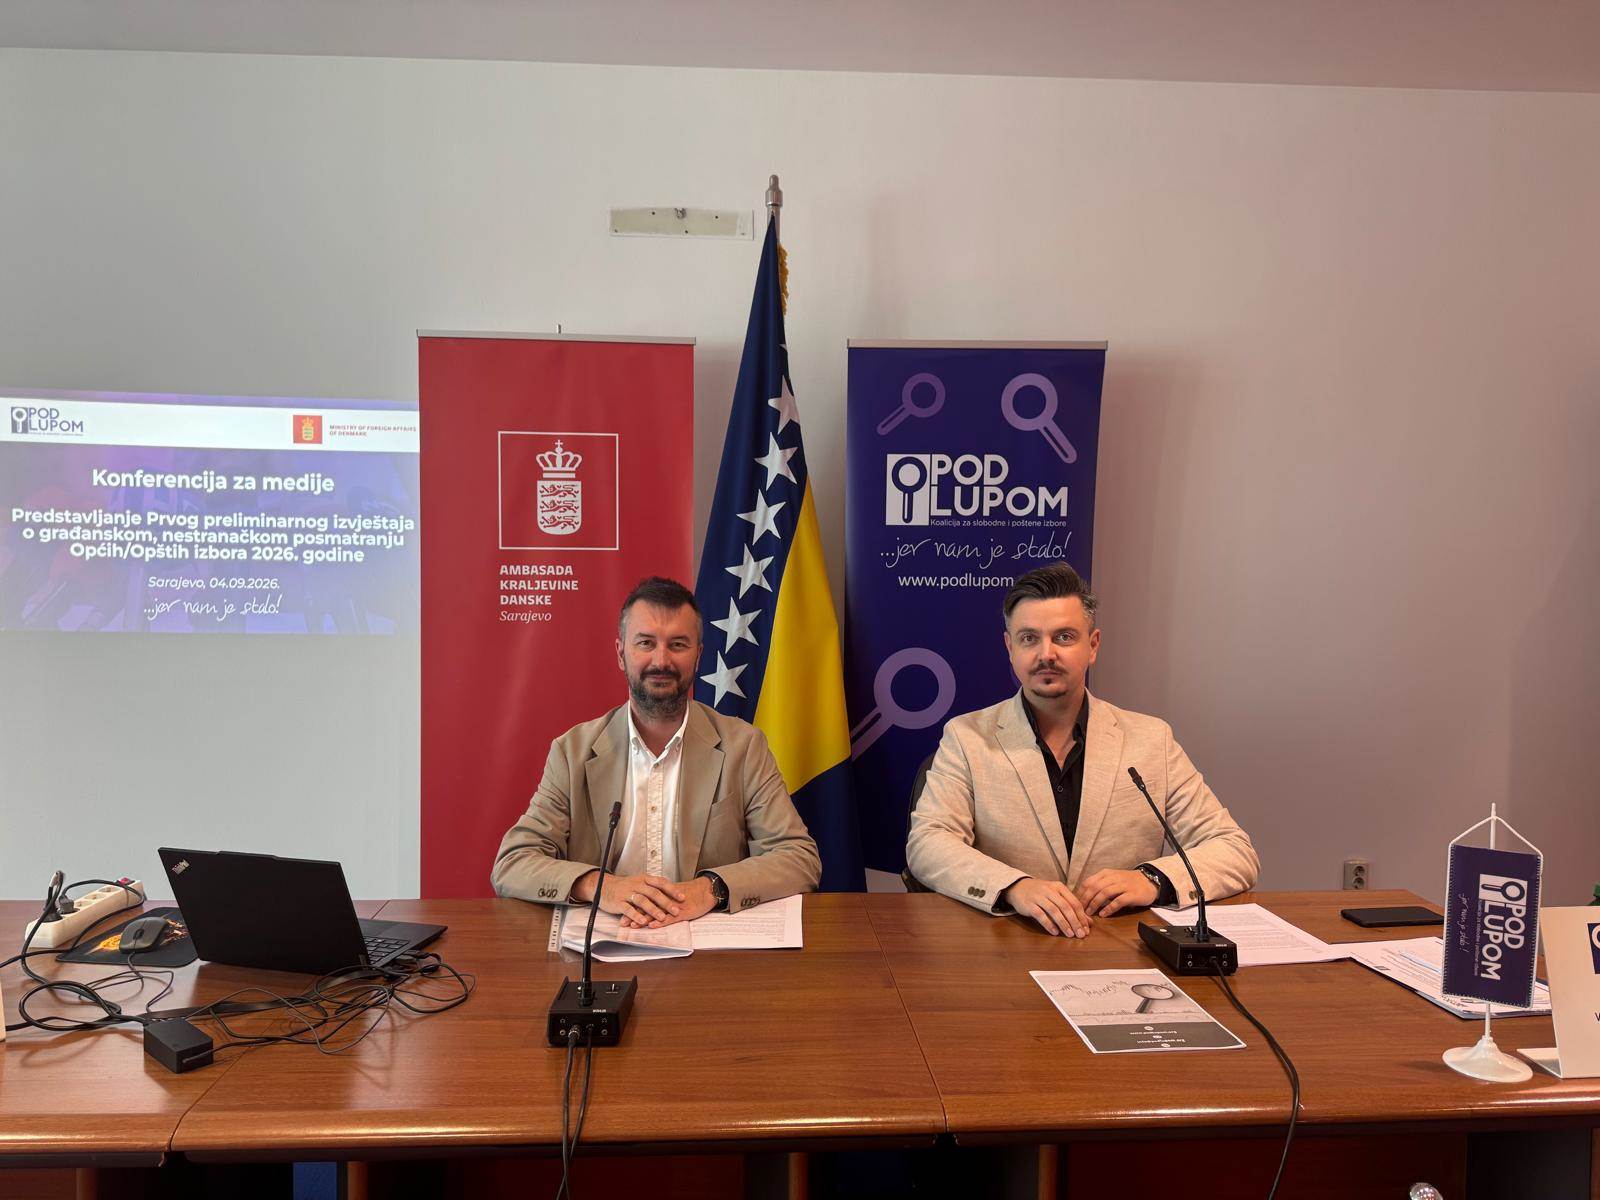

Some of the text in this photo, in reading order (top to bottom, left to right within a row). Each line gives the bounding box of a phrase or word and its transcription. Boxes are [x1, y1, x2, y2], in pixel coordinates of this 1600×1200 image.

[28, 407, 60, 420] POD
[28, 419, 84, 432] LUPOM
[931, 453, 1009, 485] POD
[92, 468, 335, 496] Konferencija za medije
[930, 486, 1069, 517] LUPOM
[11, 508, 415, 533] Predstavljanje Prvog preliminarnog izvještaja
[930, 519, 961, 527] Koalicija
[1011, 519, 1042, 528] poštene
[1043, 519, 1067, 527] izbore
[22, 526, 405, 549] o građanskom, nestranačkom posmatranju
[70, 541, 365, 565] Općih/Opštih izbora 2026. godine
[935, 541, 981, 559] nam
[979, 538, 1005, 569] je
[1011, 530, 1072, 559] stalo!
[499, 564, 574, 576] AMBASADA
[898, 573, 1014, 590] www.podlupom
[147, 576, 280, 590] Sarajevo, 04.09.2026.
[500, 579, 579, 591] KRALJEVINE
[183, 601, 218, 614] nam
[216, 599, 236, 622] je
[240, 593, 283, 615] stalo!
[500, 594, 552, 606] DANSKE
[499, 610, 552, 624] Sarajevo
[1504, 903, 1527, 949] POD
[1480, 900, 1505, 980] LUPOM
